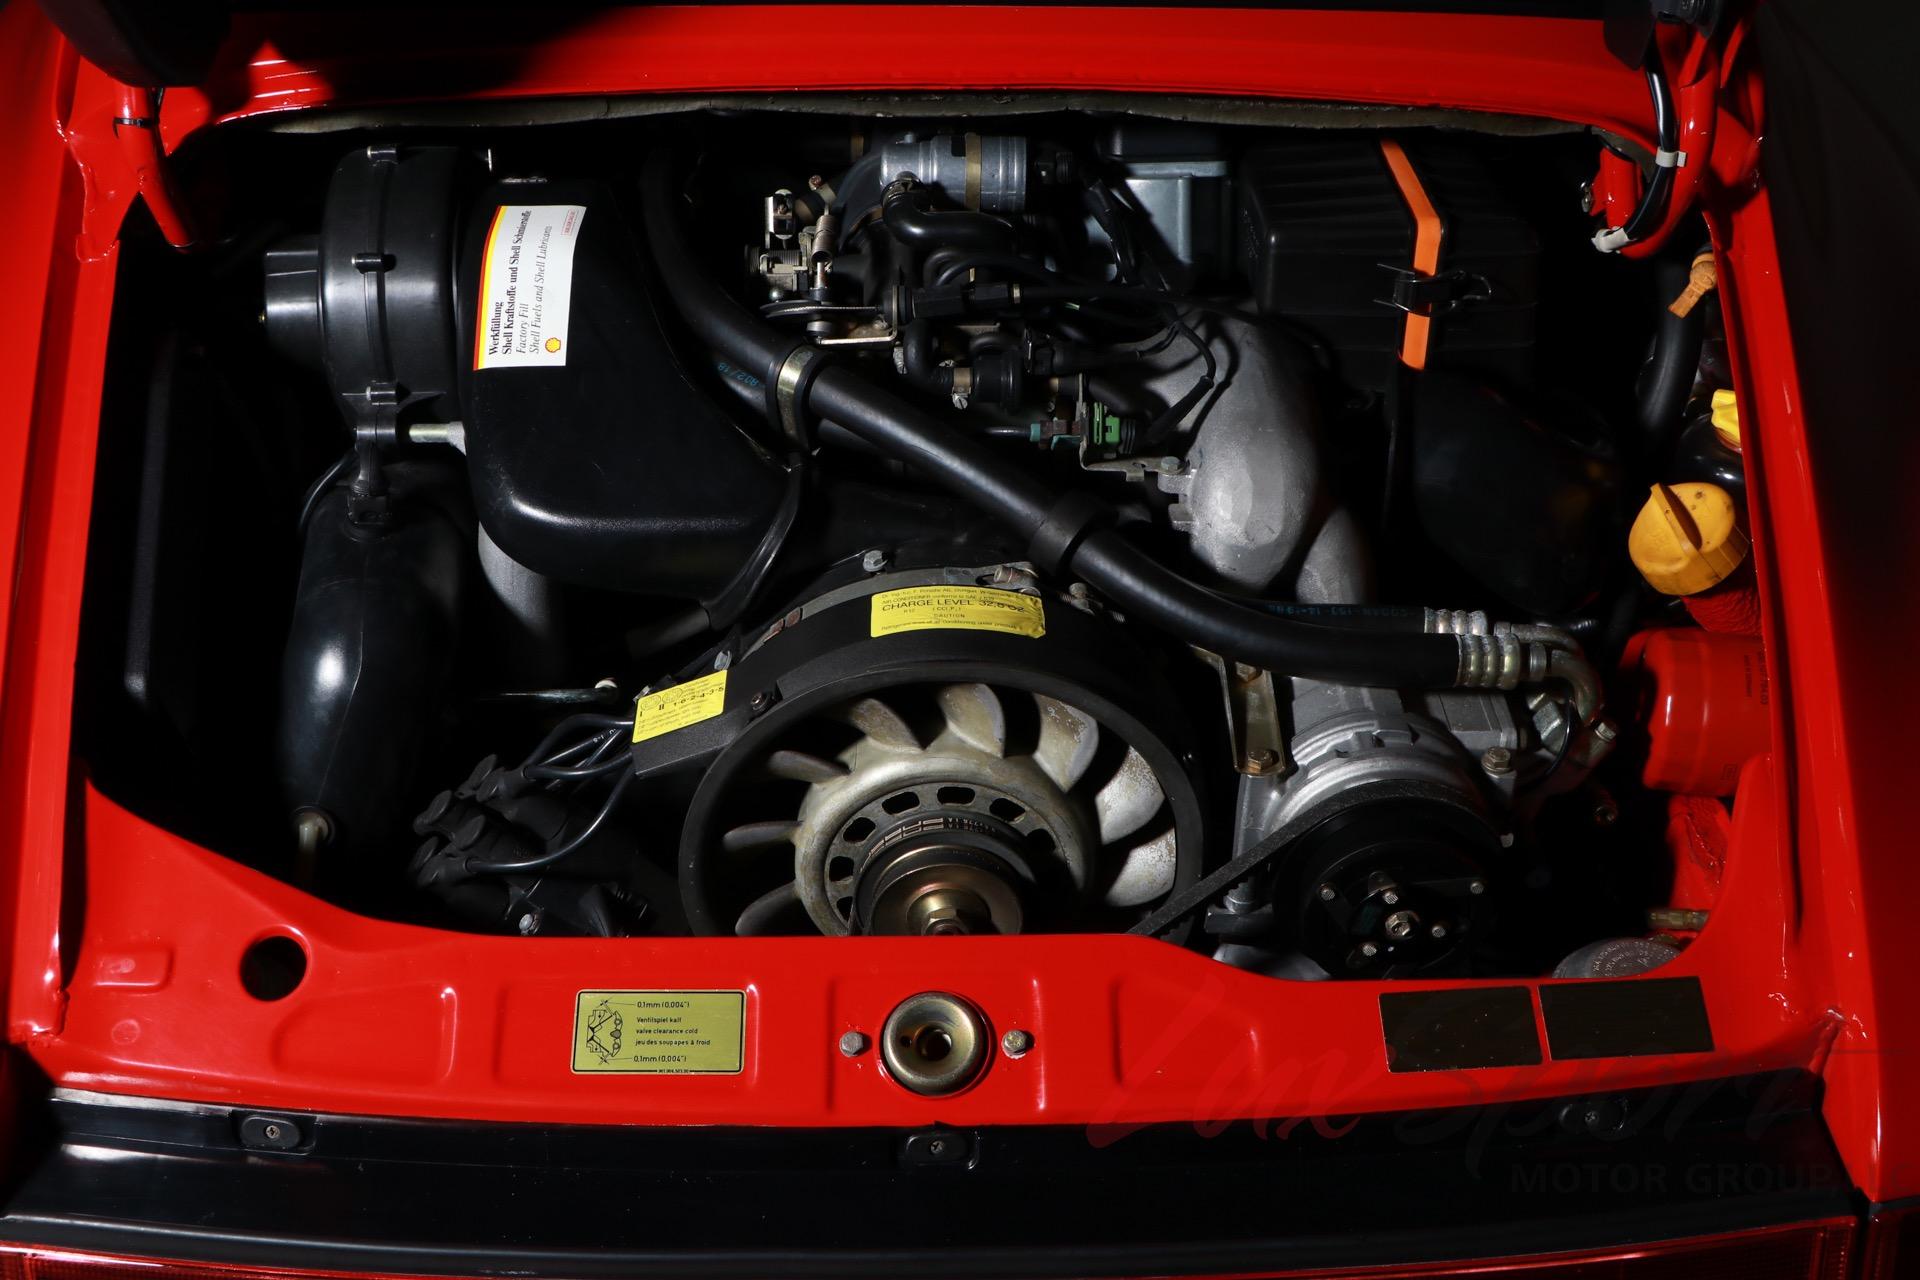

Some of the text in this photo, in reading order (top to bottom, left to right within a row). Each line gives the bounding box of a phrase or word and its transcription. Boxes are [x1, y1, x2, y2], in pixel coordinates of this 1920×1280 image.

[502, 210, 532, 355] Shell Kraftstoffe und Shell Schmierstoffe
[534, 261, 545, 284] Shell
[534, 285, 544, 302] and
[531, 304, 543, 329] Fuels
[489, 302, 503, 355] Werkfüllung
[516, 303, 529, 354] Factory Fill
[529, 331, 541, 354] Shell
[882, 598, 934, 612] CHARGE
[936, 598, 974, 606] LEVEL
[636, 1017, 668, 1025] Ventilspiel
